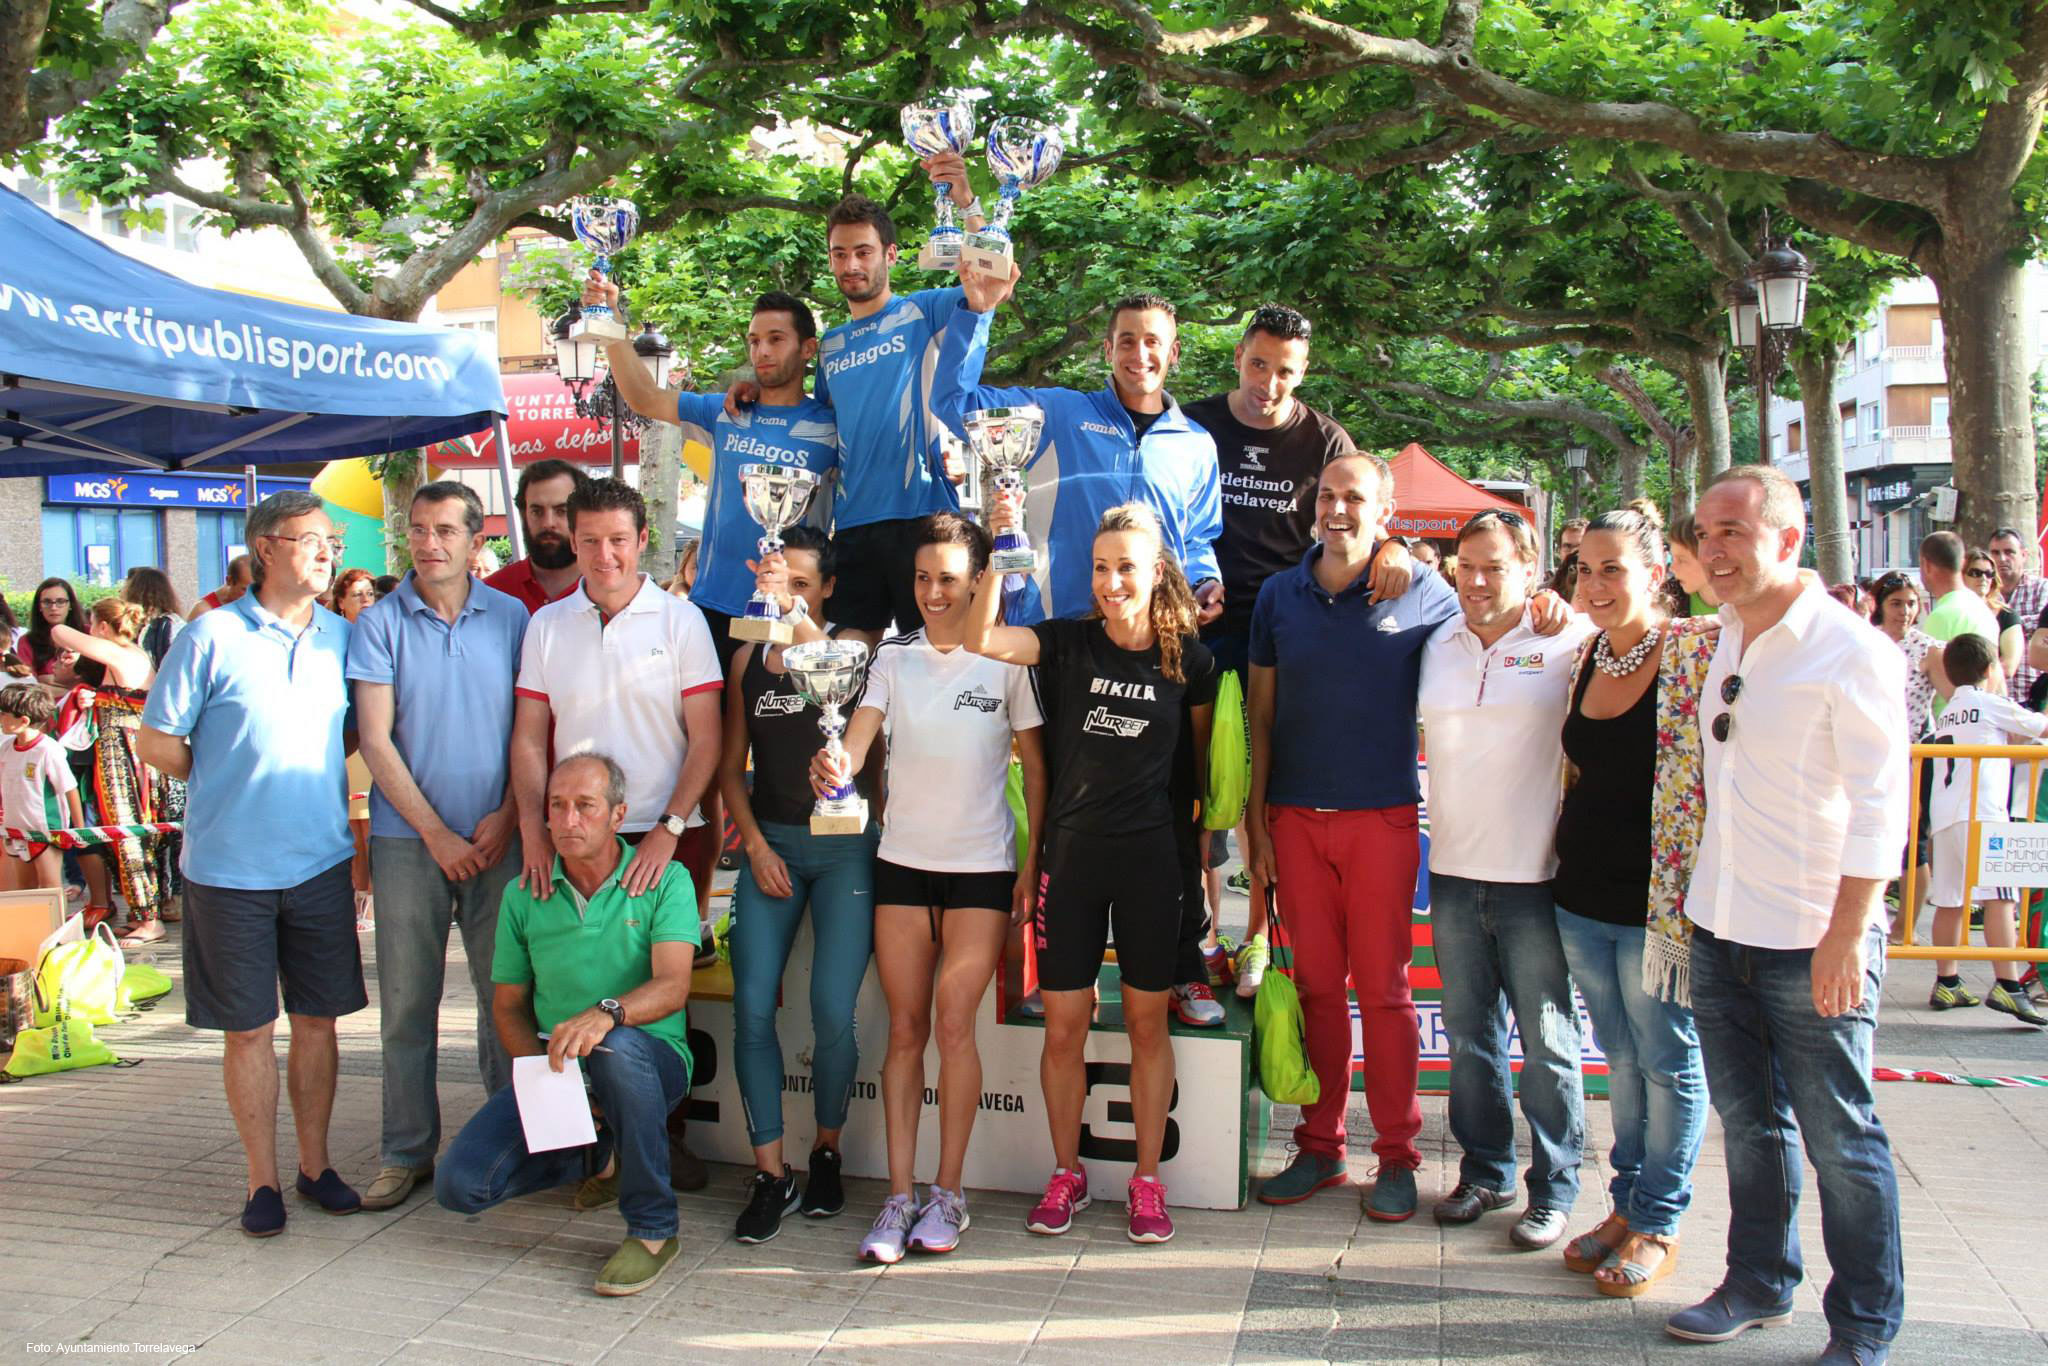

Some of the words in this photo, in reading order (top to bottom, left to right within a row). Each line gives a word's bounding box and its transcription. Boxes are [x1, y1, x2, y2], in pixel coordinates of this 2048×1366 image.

[517, 407, 577, 421] TORRE
[74, 482, 112, 499] MGS
[1220, 472, 1294, 493] tletismO
[197, 488, 229, 503] MGS
[1089, 677, 1157, 702] BIKILA
[1984, 861, 2003, 873] DE
[1078, 1061, 1180, 1163] 3
